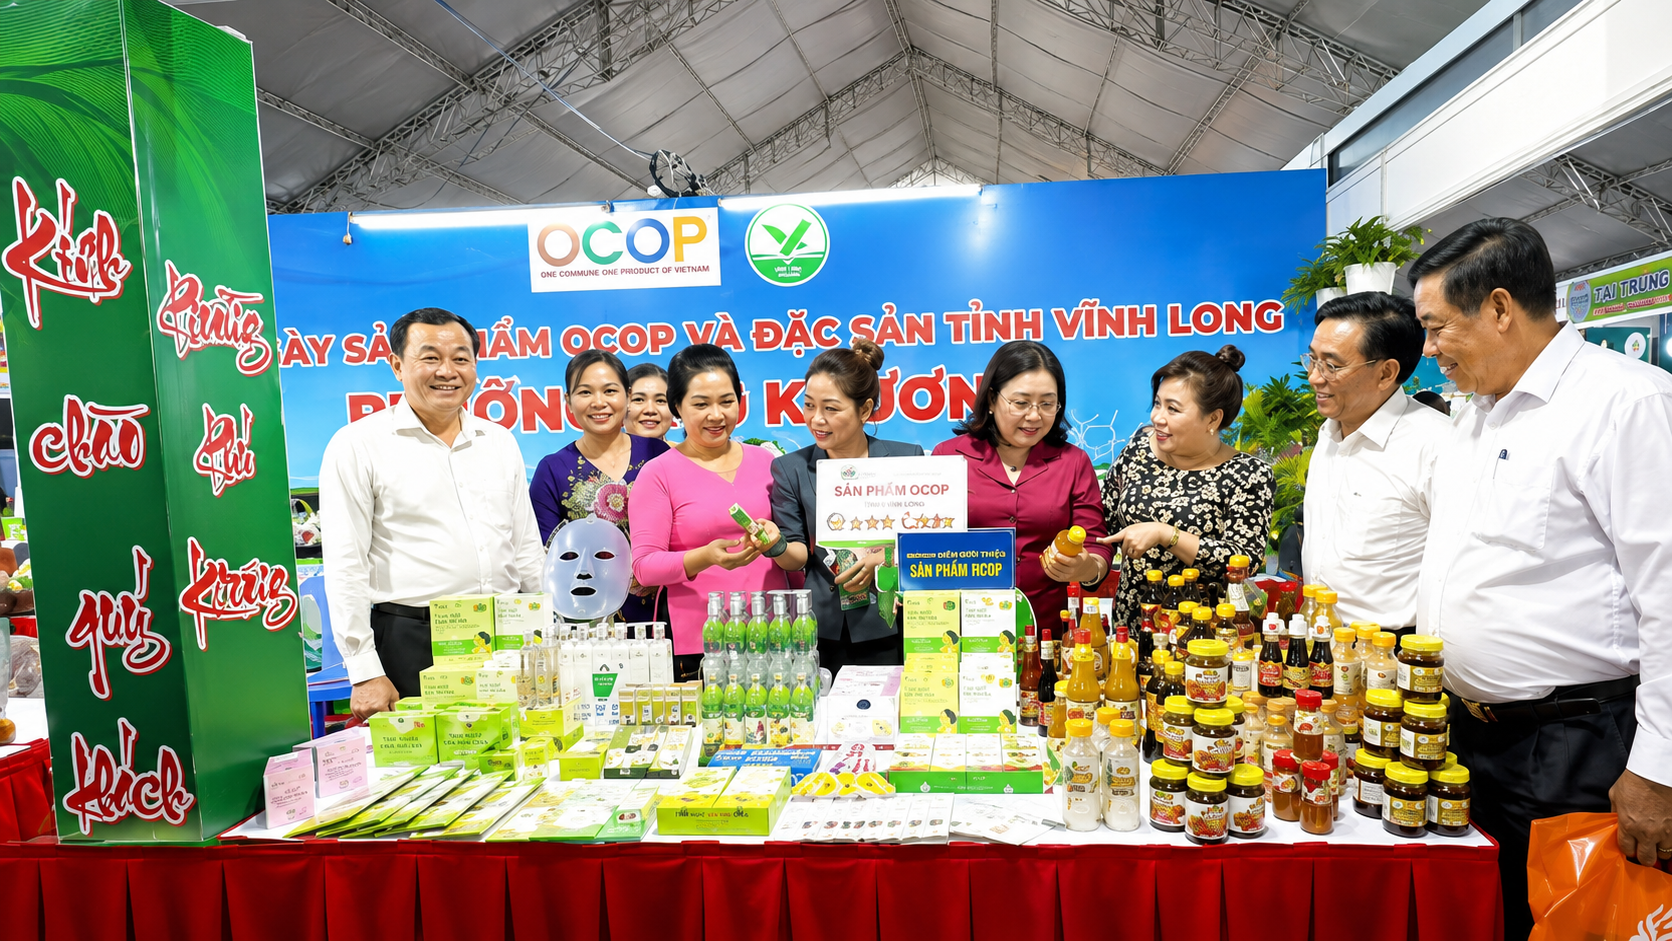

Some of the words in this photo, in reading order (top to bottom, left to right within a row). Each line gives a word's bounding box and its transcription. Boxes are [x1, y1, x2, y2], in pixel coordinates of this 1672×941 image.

[537, 216, 708, 267] OCOP
[540, 271, 558, 279] ONE
[559, 269, 600, 278] COMMUNE
[601, 268, 619, 276] ONE
[661, 266, 673, 274] OF
[674, 265, 710, 273] VIETNAM
[1619, 270, 1670, 298] TRUNG
[343, 323, 391, 364] SẢ
[562, 322, 676, 355] OCOP
[686, 313, 744, 352] VÀ
[751, 310, 841, 357] ĐẶC
[851, 303, 935, 345] SẢN
[945, 300, 1042, 342] TỈNH
[1052, 298, 1157, 339] VĨNH
[1168, 301, 1285, 335] LONG
[910, 484, 950, 496] OCOP
